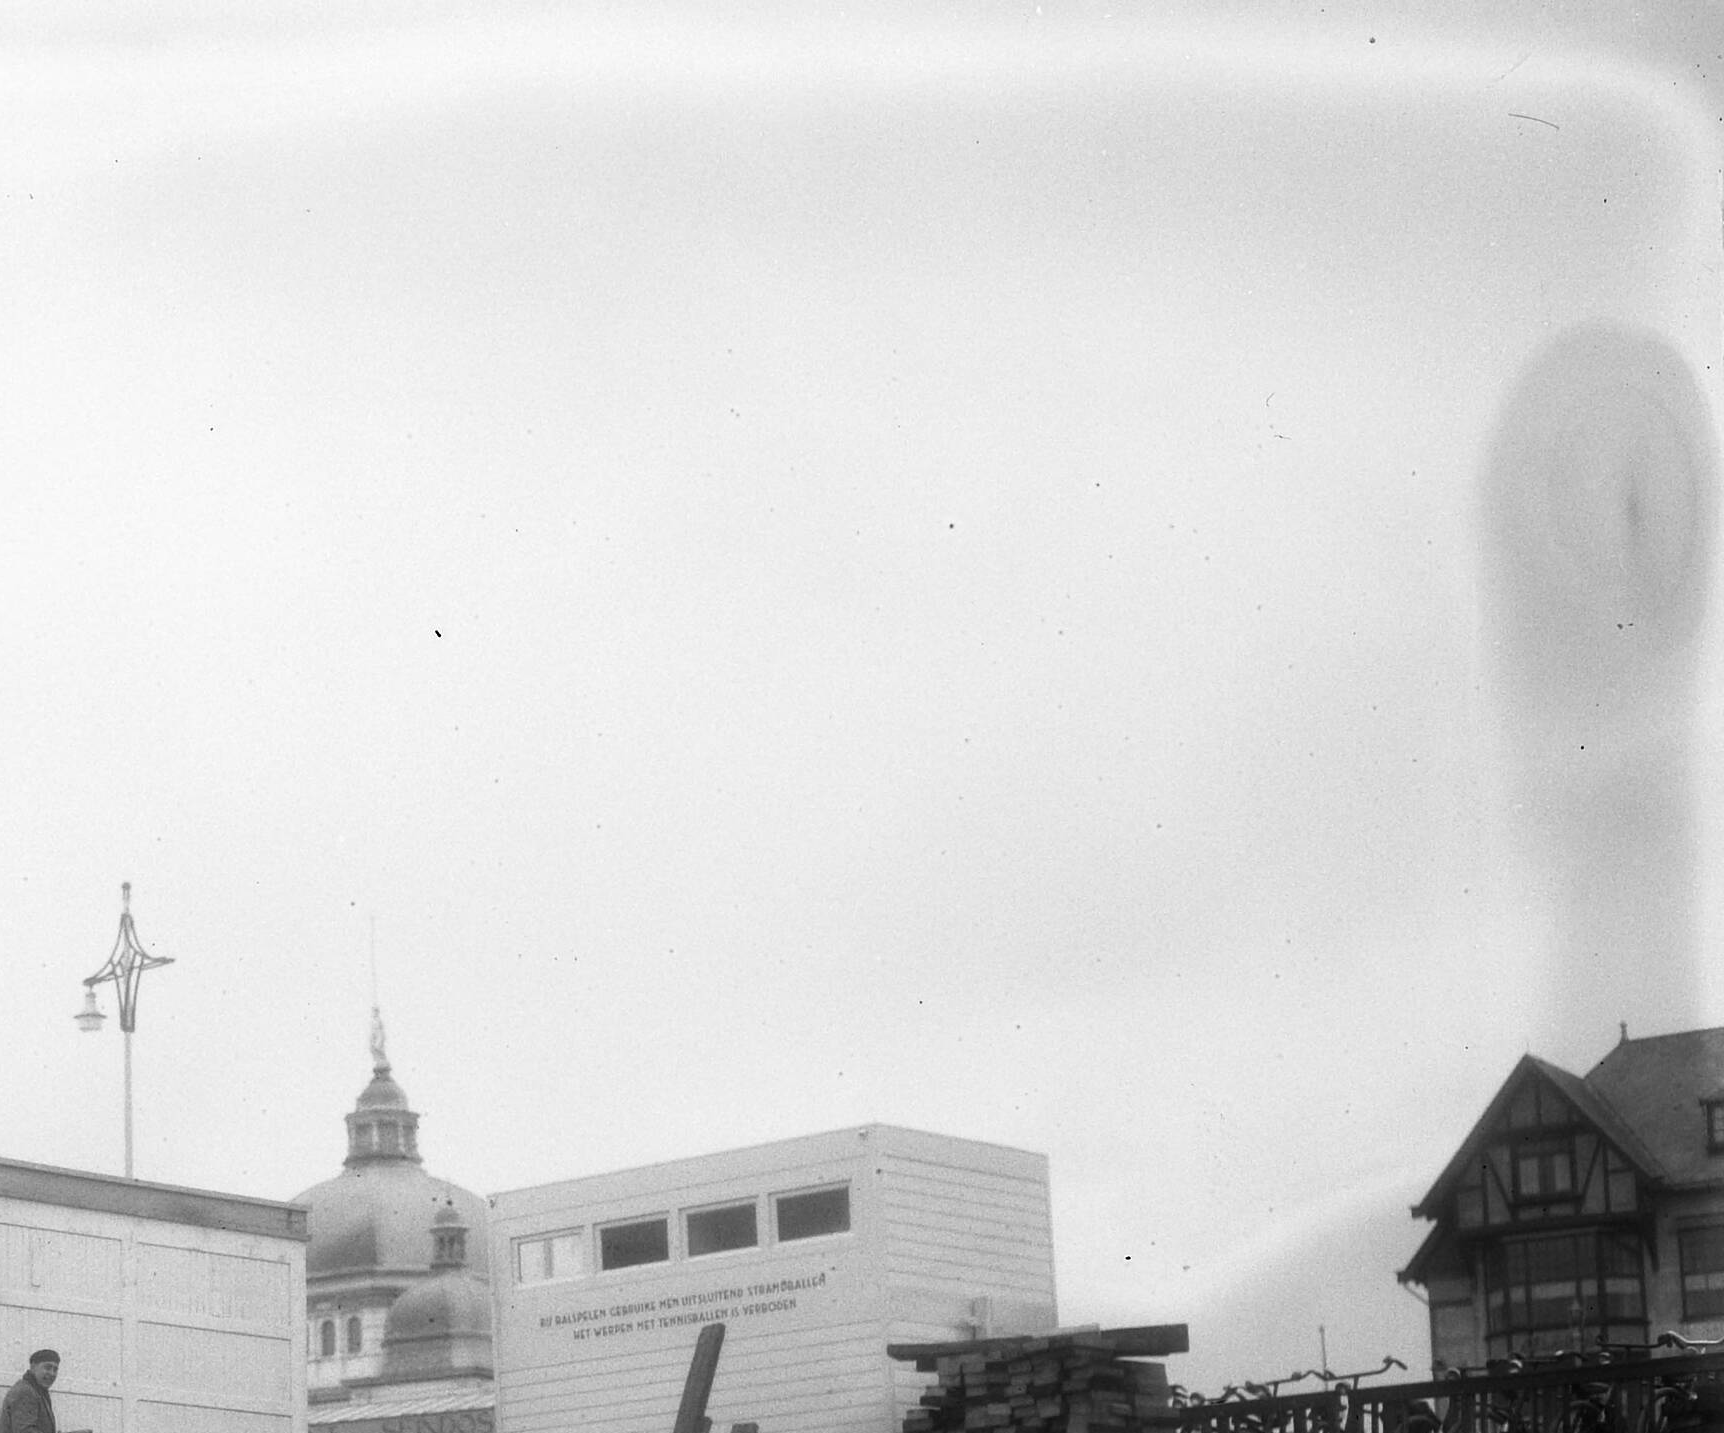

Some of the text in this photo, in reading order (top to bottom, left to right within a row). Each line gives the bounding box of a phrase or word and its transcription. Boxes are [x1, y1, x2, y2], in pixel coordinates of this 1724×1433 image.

[554, 1308, 607, 1326] BALSPELEN
[609, 1300, 657, 1318] GEBRUIKE
[659, 1297, 679, 1310] MEN
[681, 1287, 744, 1306] UITSLUITEND
[747, 1272, 827, 1297] STRANDBALLEN
[573, 1297, 798, 1340] HET WERPEN MET TENNISBALLEN IS VERBODEN
